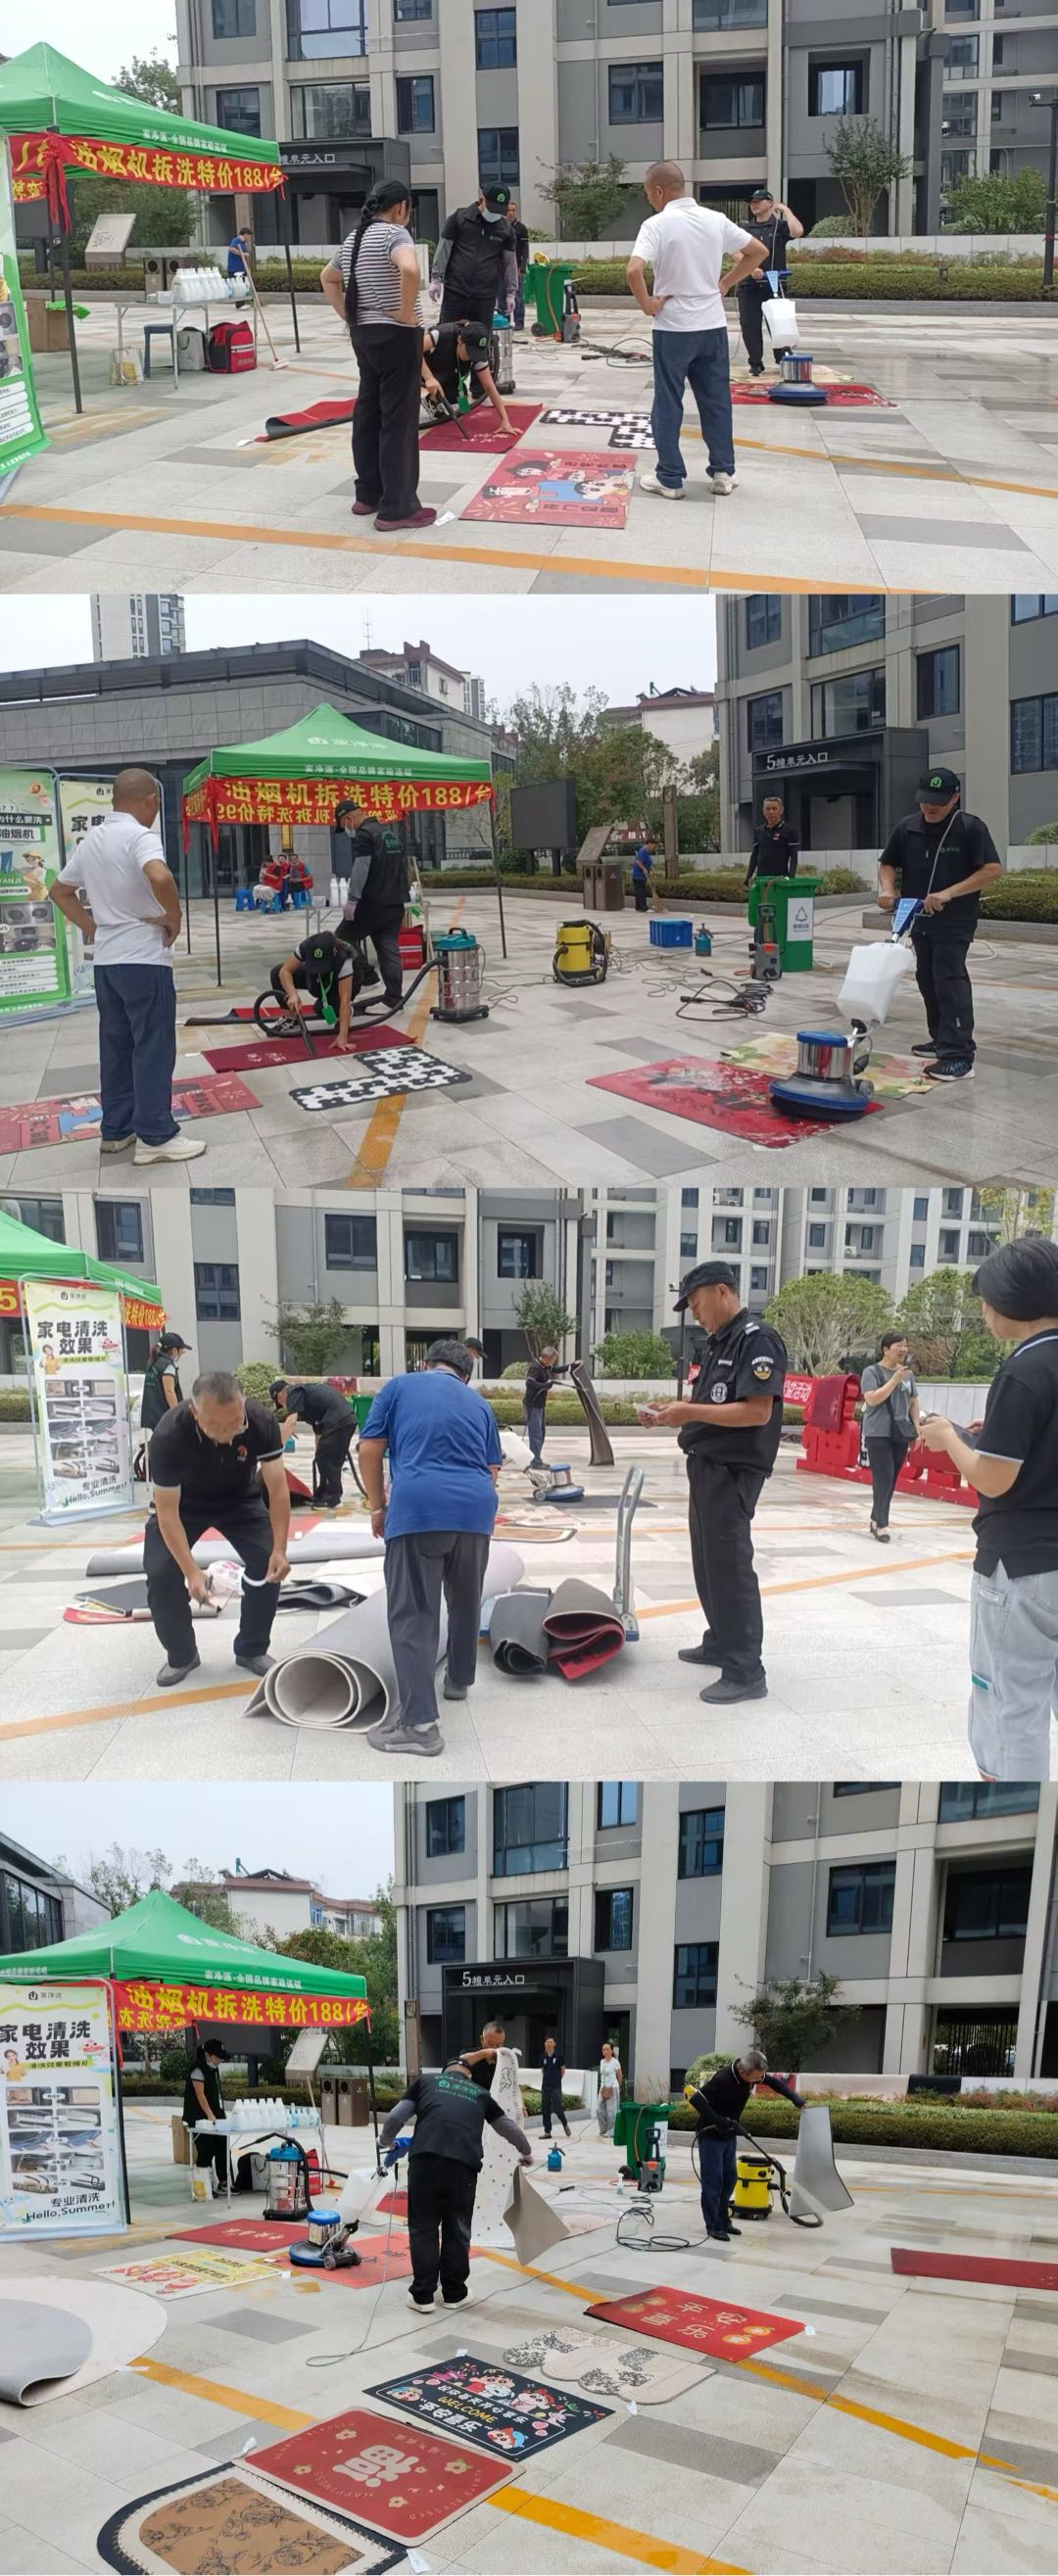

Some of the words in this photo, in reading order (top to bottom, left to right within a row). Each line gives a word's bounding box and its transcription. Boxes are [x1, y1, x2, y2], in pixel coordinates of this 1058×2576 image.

[37, 1319, 109, 1340] 家电清洗
[59, 1336, 93, 1356] 效果
[81, 1474, 118, 1491] 专业清洗
[461, 1971, 526, 1987] 5幢单元入口
[0, 2020, 91, 2043] 家电清洗
[25, 2039, 70, 2061] 效果
[51, 2192, 100, 2208] 专业清洗
[437, 2396, 499, 2423] WELCOME
[332, 2444, 420, 2489] 福
